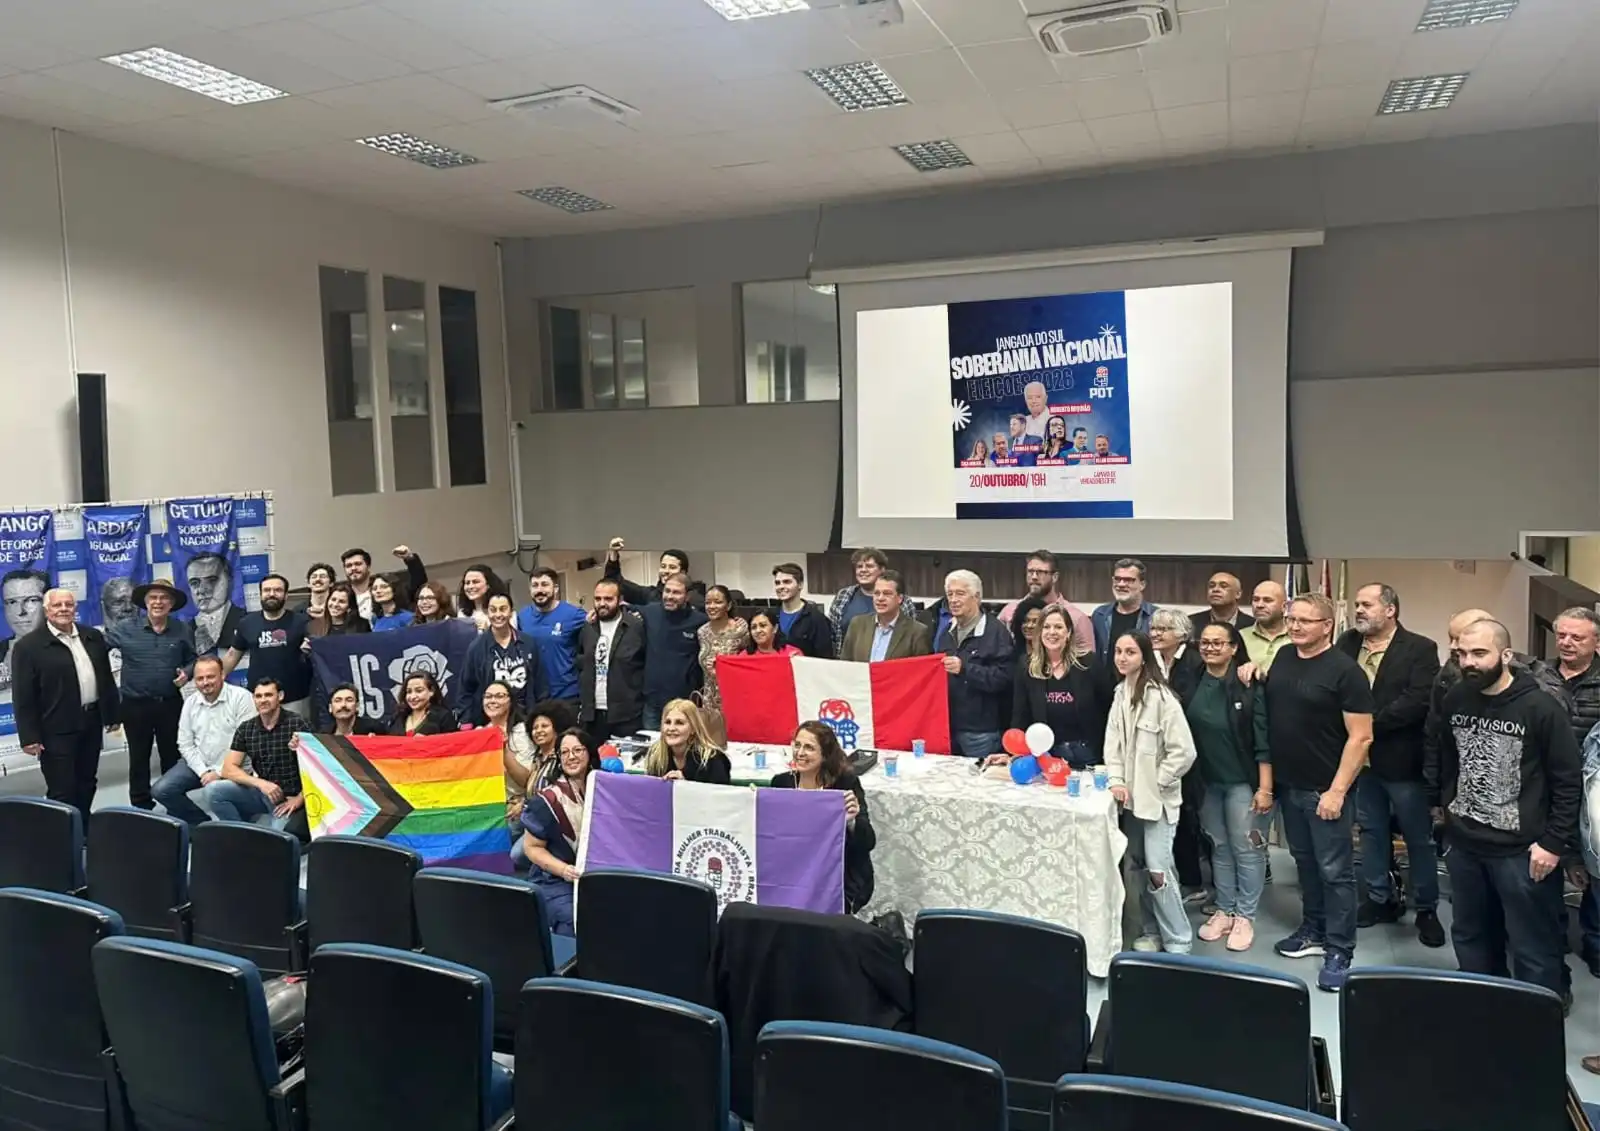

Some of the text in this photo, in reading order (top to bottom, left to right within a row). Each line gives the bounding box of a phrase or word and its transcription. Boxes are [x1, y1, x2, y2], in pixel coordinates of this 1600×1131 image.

[996, 329, 1065, 353] JANGADA DO SUL
[951, 335, 1126, 380] SOBERANIA NACIONAL
[1089, 387, 1114, 399] PDT
[170, 500, 231, 518] GETÚLIO
[0, 551, 12, 562] DE
[19, 547, 44, 562] BASE
[258, 631, 272, 642] JS
[349, 653, 384, 719] JS
[676, 830, 702, 859] MULHER
[704, 828, 752, 868] TRABALHISTA
[744, 876, 755, 903] BRAS
